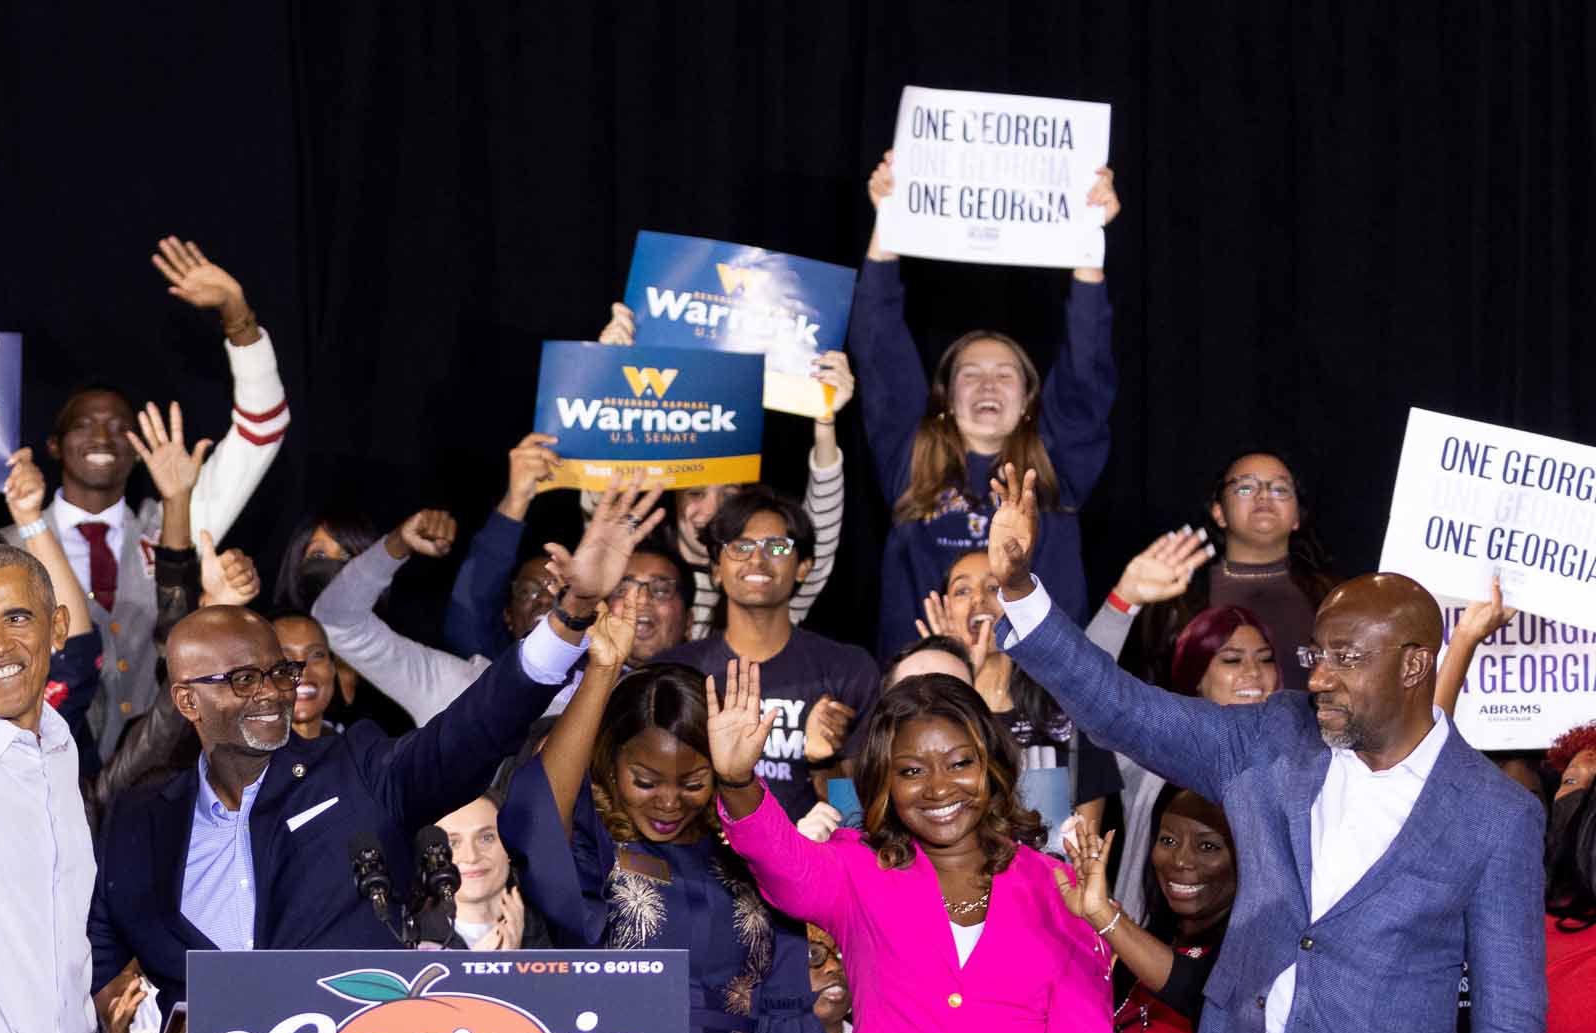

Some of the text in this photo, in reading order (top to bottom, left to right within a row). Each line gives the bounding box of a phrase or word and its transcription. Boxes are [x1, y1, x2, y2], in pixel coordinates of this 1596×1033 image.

[912, 105, 1074, 150] ONE GEORGIA
[908, 180, 1070, 224] ONE GEORGIA
[646, 286, 821, 346] Wark
[556, 397, 737, 432] Warnock
[645, 432, 698, 444] SENATE
[1440, 436, 1596, 505] ONE GEORG
[1424, 515, 1482, 559] ONE
[1479, 653, 1596, 694] GEORGI
[1479, 704, 1541, 715] ABRAMS
[461, 961, 665, 976] TEXT VOTE TO 60150
